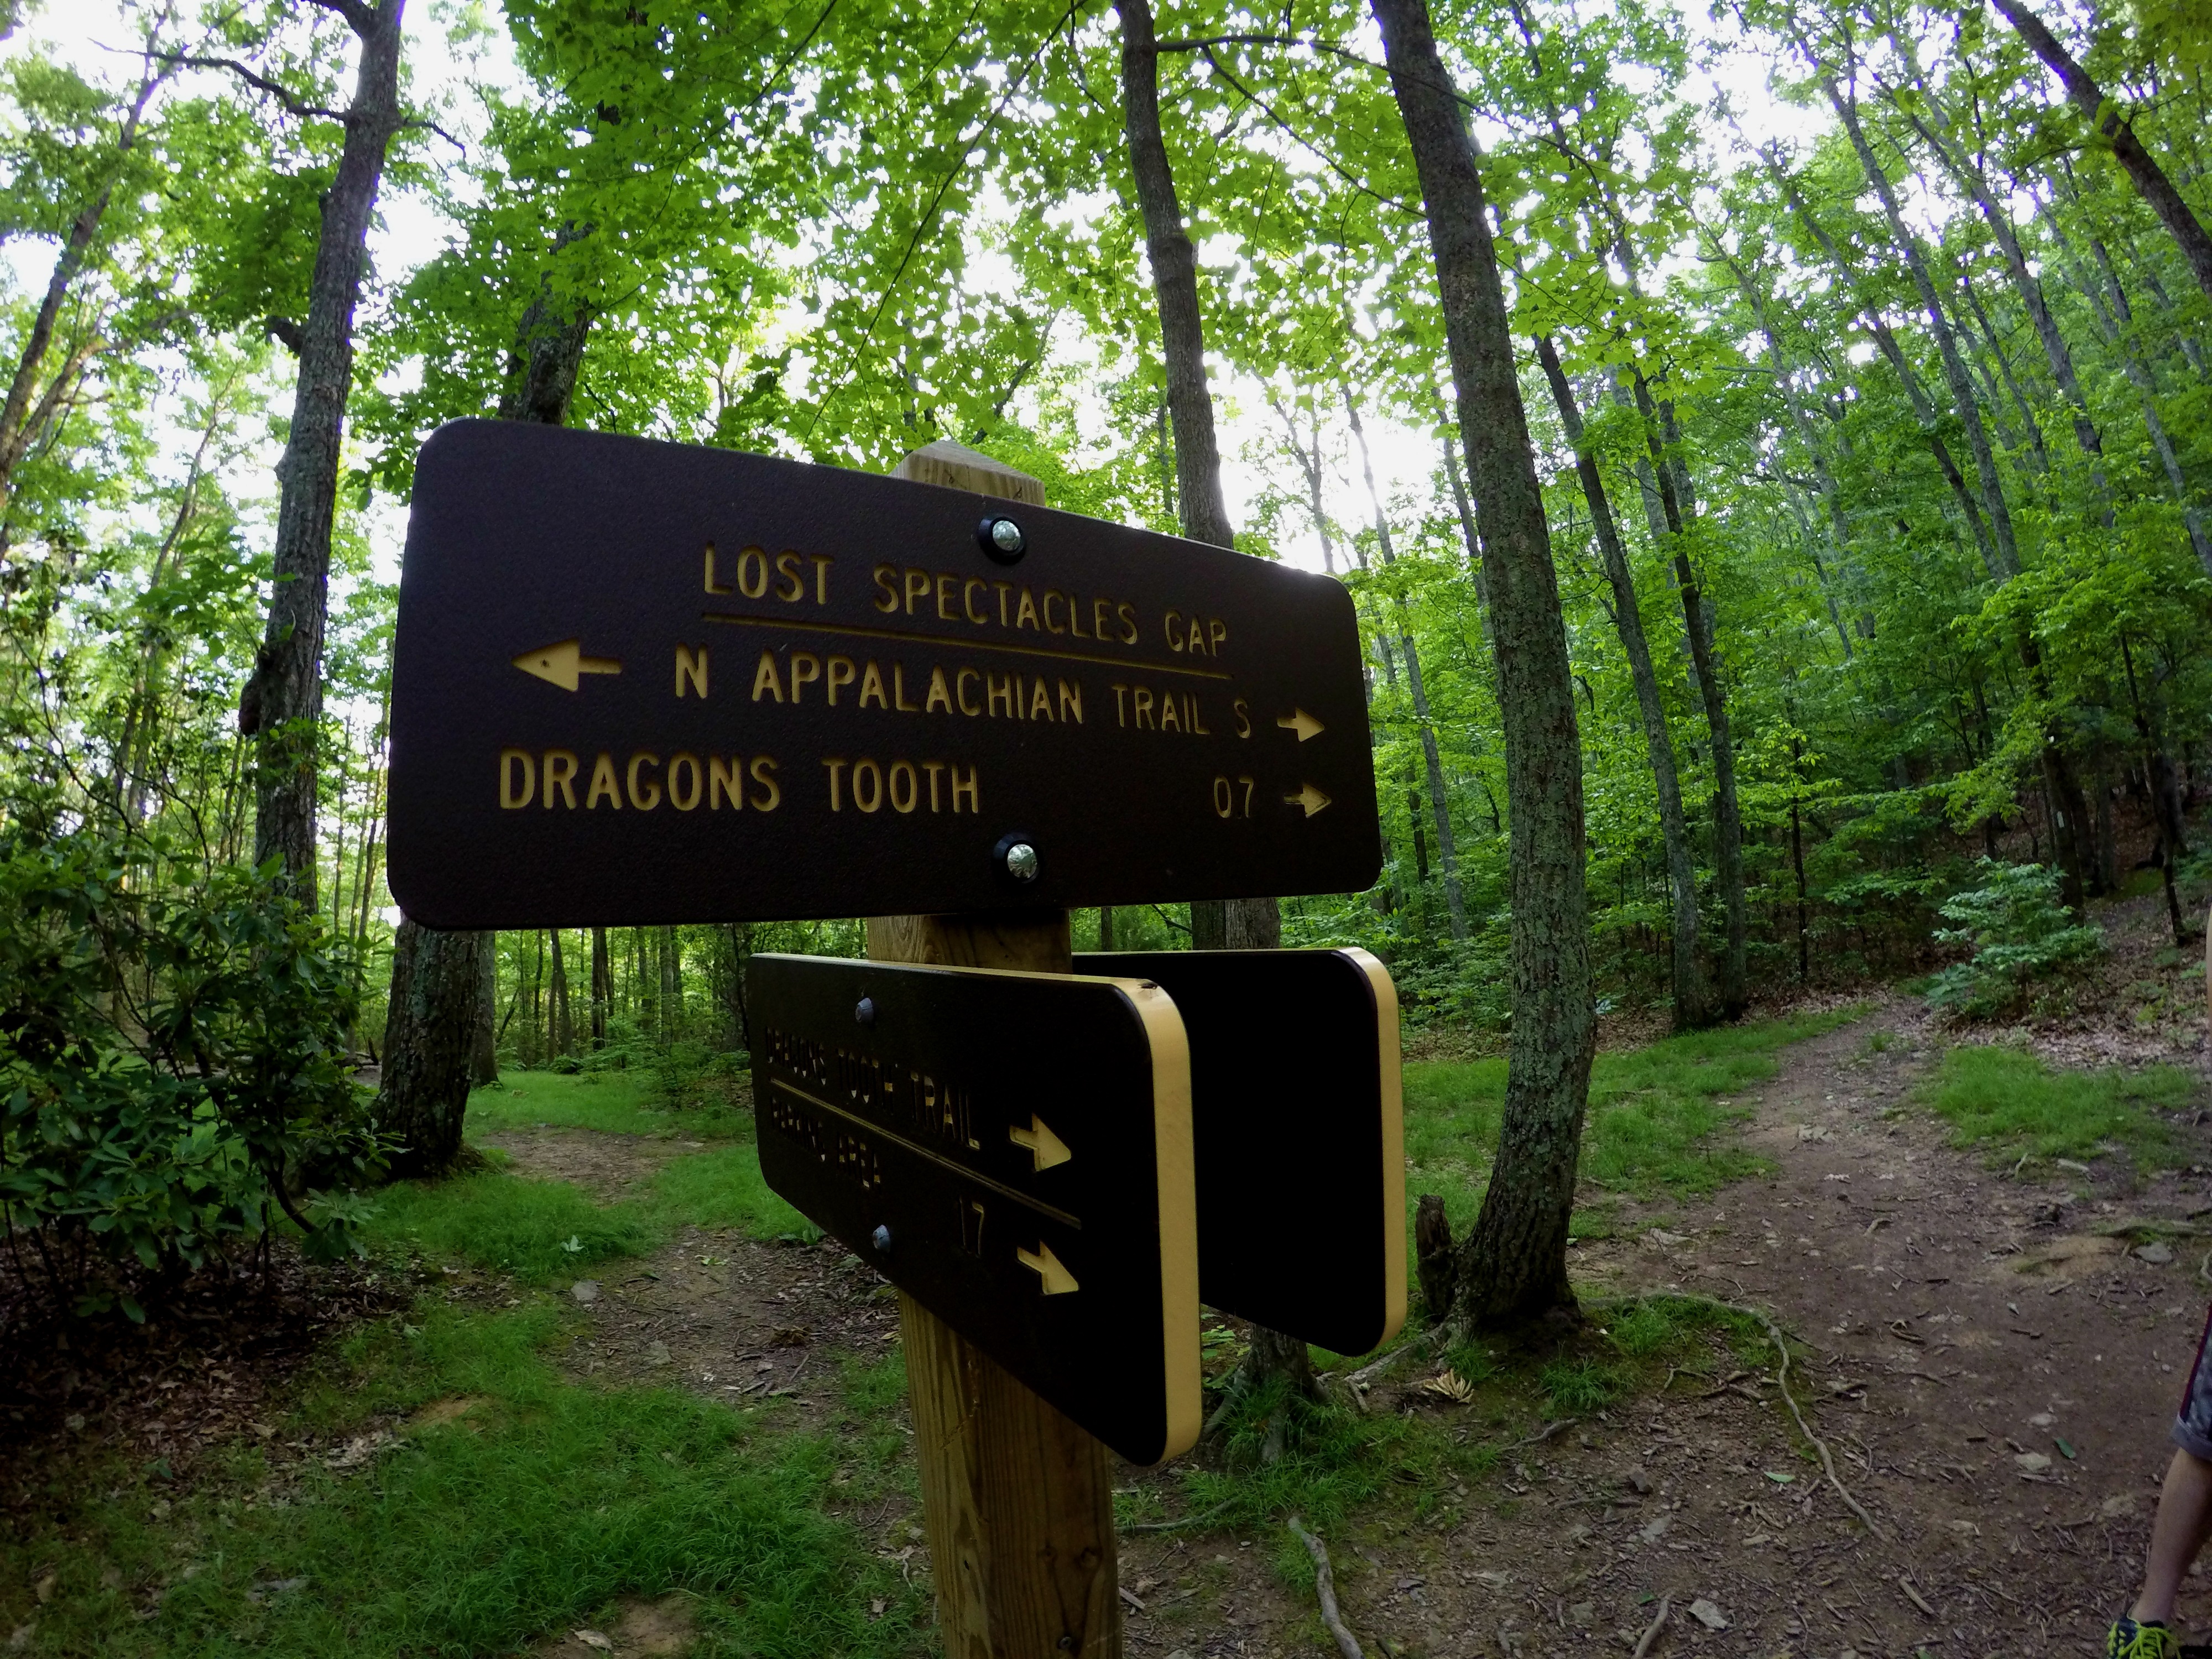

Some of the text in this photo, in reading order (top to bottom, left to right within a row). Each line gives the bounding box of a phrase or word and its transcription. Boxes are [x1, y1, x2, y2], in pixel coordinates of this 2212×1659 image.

[704, 541, 1228, 657] LOST SPECTACLES GAP
[675, 642, 1253, 739] N APPALACHIAN TRAIL S
[499, 745, 781, 812] DRAGONS
[821, 757, 979, 814] TOOTH
[836, 1048, 894, 1115] TOOTH
[907, 1070, 982, 1151] TRAIL
[836, 1131, 883, 1194] AREA
